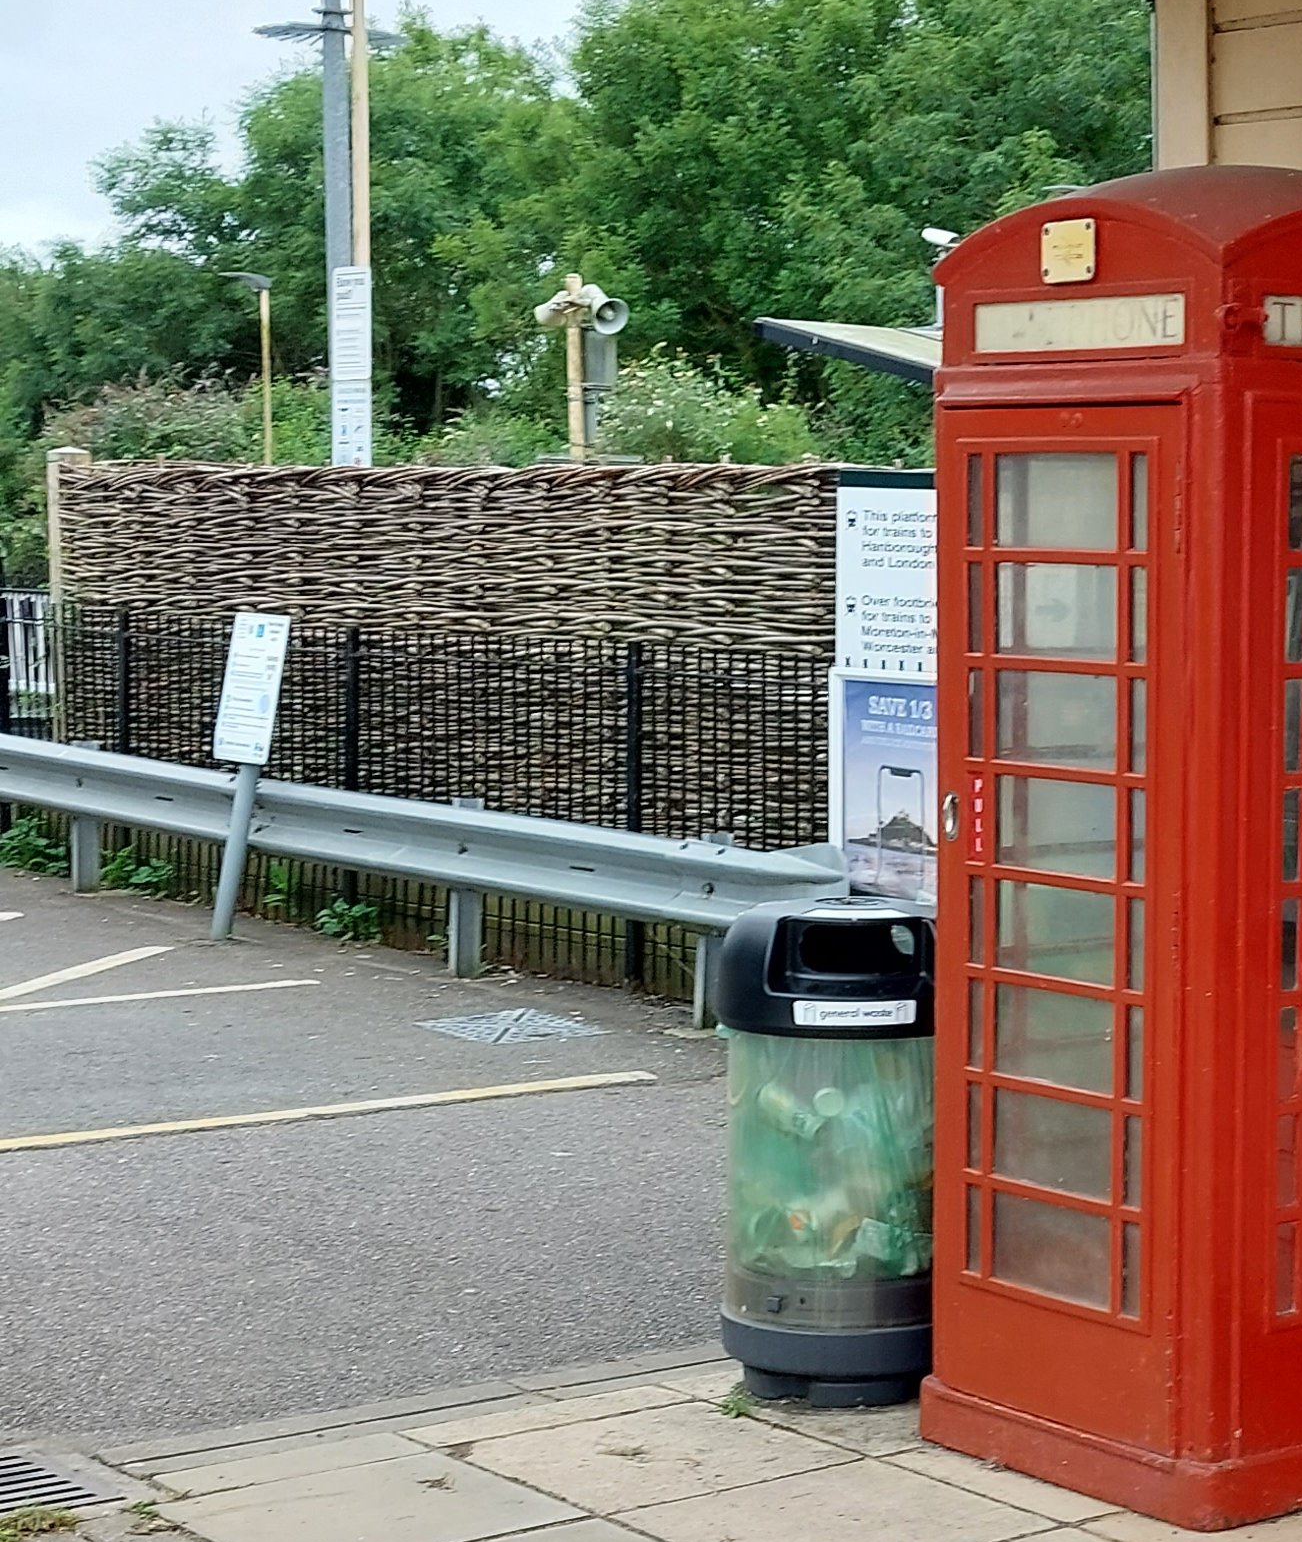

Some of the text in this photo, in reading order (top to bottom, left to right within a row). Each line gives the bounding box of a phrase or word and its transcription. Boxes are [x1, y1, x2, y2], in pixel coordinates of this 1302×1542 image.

[862, 510, 937, 524] This platfor
[862, 526, 933, 539] for trains to
[861, 556, 934, 569] and London
[861, 594, 937, 608] Over footbri
[861, 611, 932, 624] for trains to
[861, 640, 923, 655] Worcester
[868, 695, 933, 720] SAVE 1/3
[973, 779, 984, 852] PULL
[819, 1007, 893, 1021] general waste
